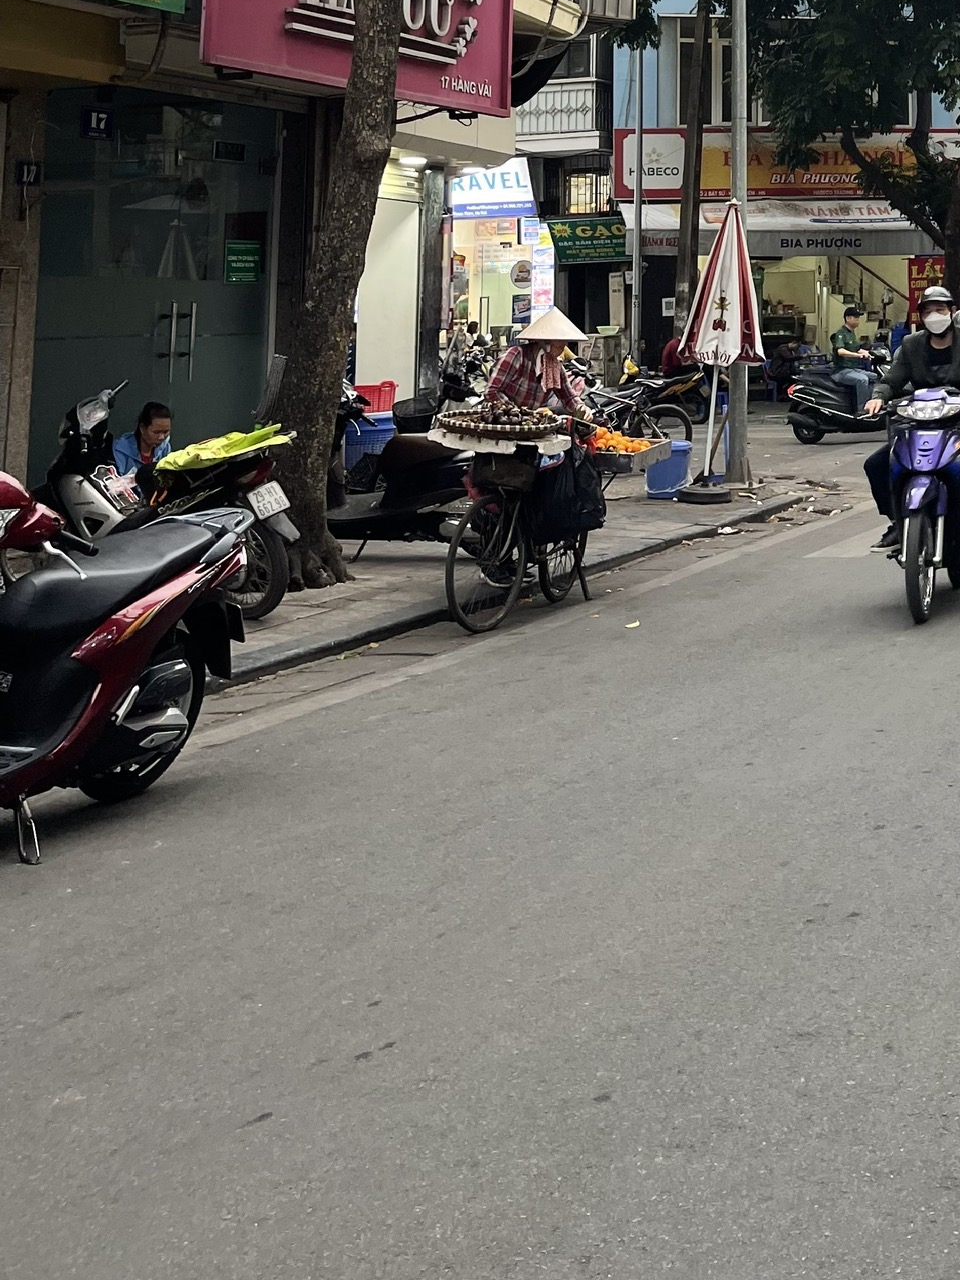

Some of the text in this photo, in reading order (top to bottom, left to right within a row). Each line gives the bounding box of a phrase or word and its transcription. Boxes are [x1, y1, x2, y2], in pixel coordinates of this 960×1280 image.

[440, 75, 492, 98] 17 HÀNG VẢI
[91, 112, 108, 130] 17
[770, 173, 796, 184] BIA
[780, 237, 862, 251] BIA PHƯỢNG
[253, 486, 278, 504] 29-H1
[257, 495, 287, 517] 662.98
